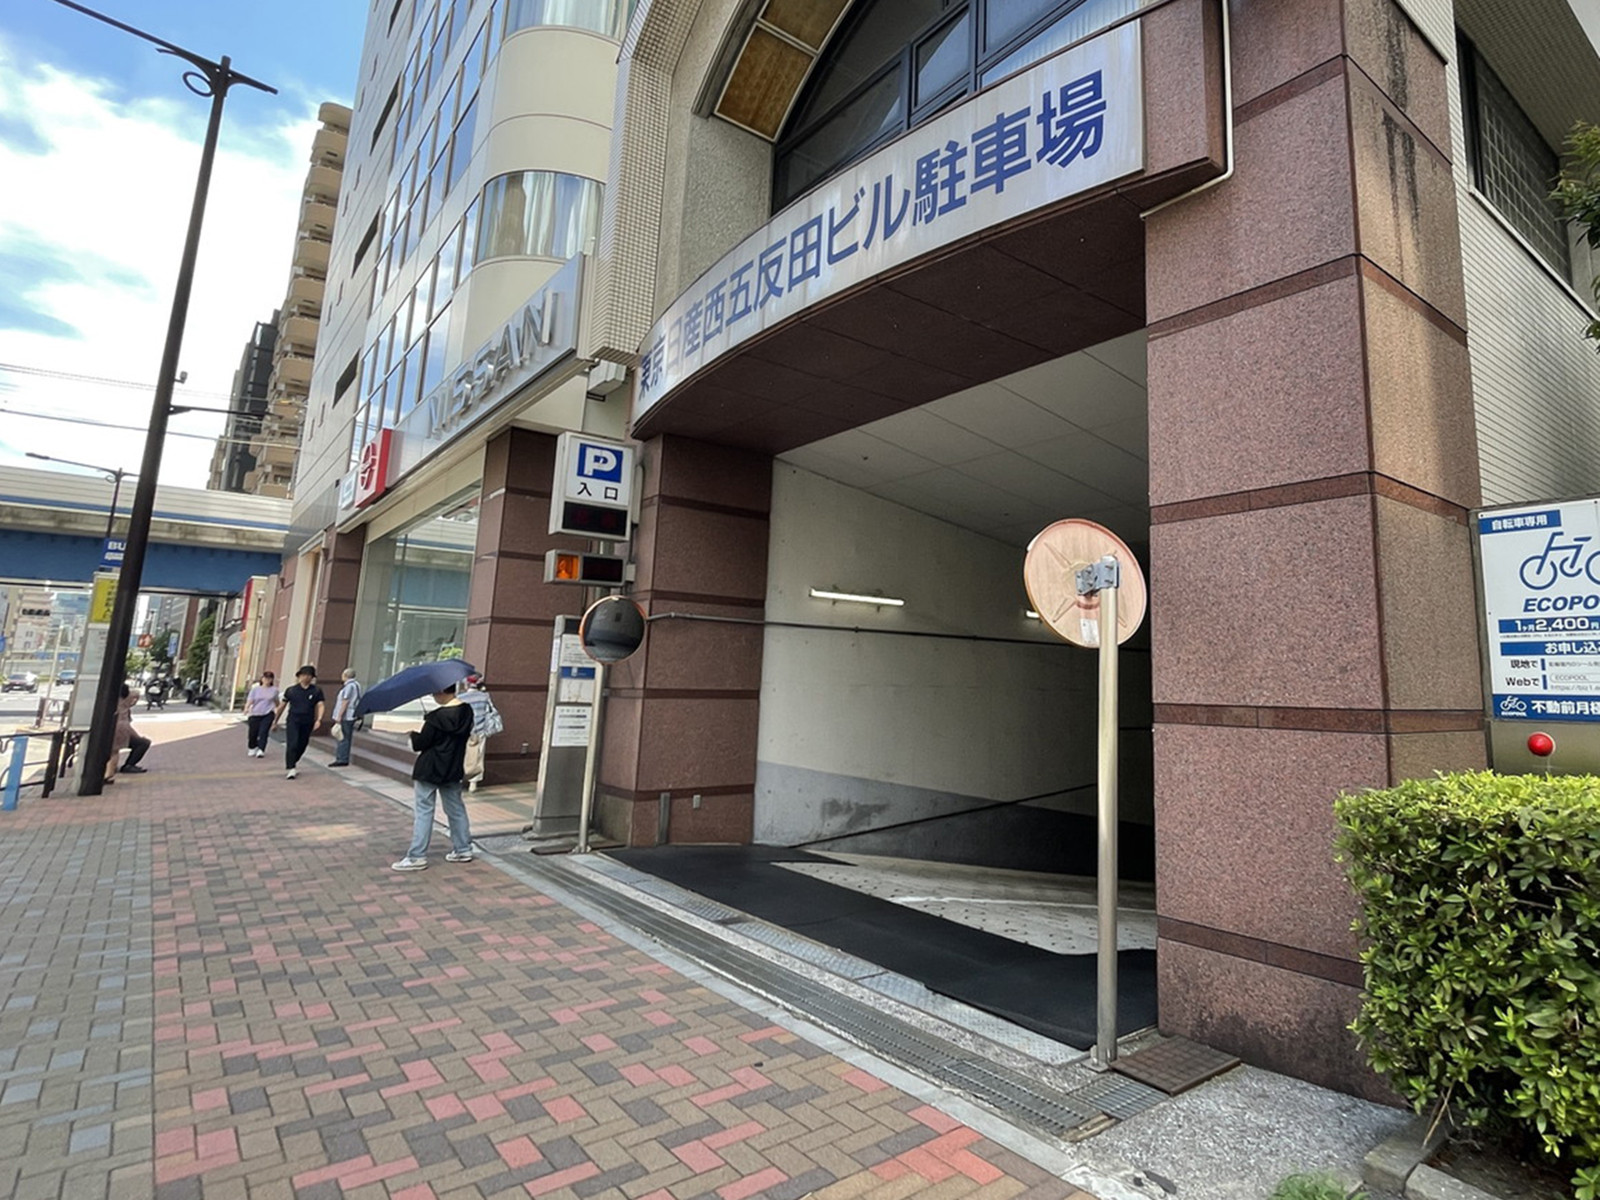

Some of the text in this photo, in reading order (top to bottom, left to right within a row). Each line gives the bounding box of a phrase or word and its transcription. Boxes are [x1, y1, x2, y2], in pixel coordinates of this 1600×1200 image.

[638, 69, 1107, 400] 東京日産西五反田ビル駐車場
[427, 290, 557, 438] NISSAN
[583, 446, 617, 477] P
[577, 482, 619, 500] 入口
[1491, 514, 1547, 530] 自転車専用
[108, 541, 126, 550] BU
[1544, 641, 1600, 655] お申し込
[1510, 659, 1538, 669] 現地で
[1505, 677, 1540, 687] Webで
